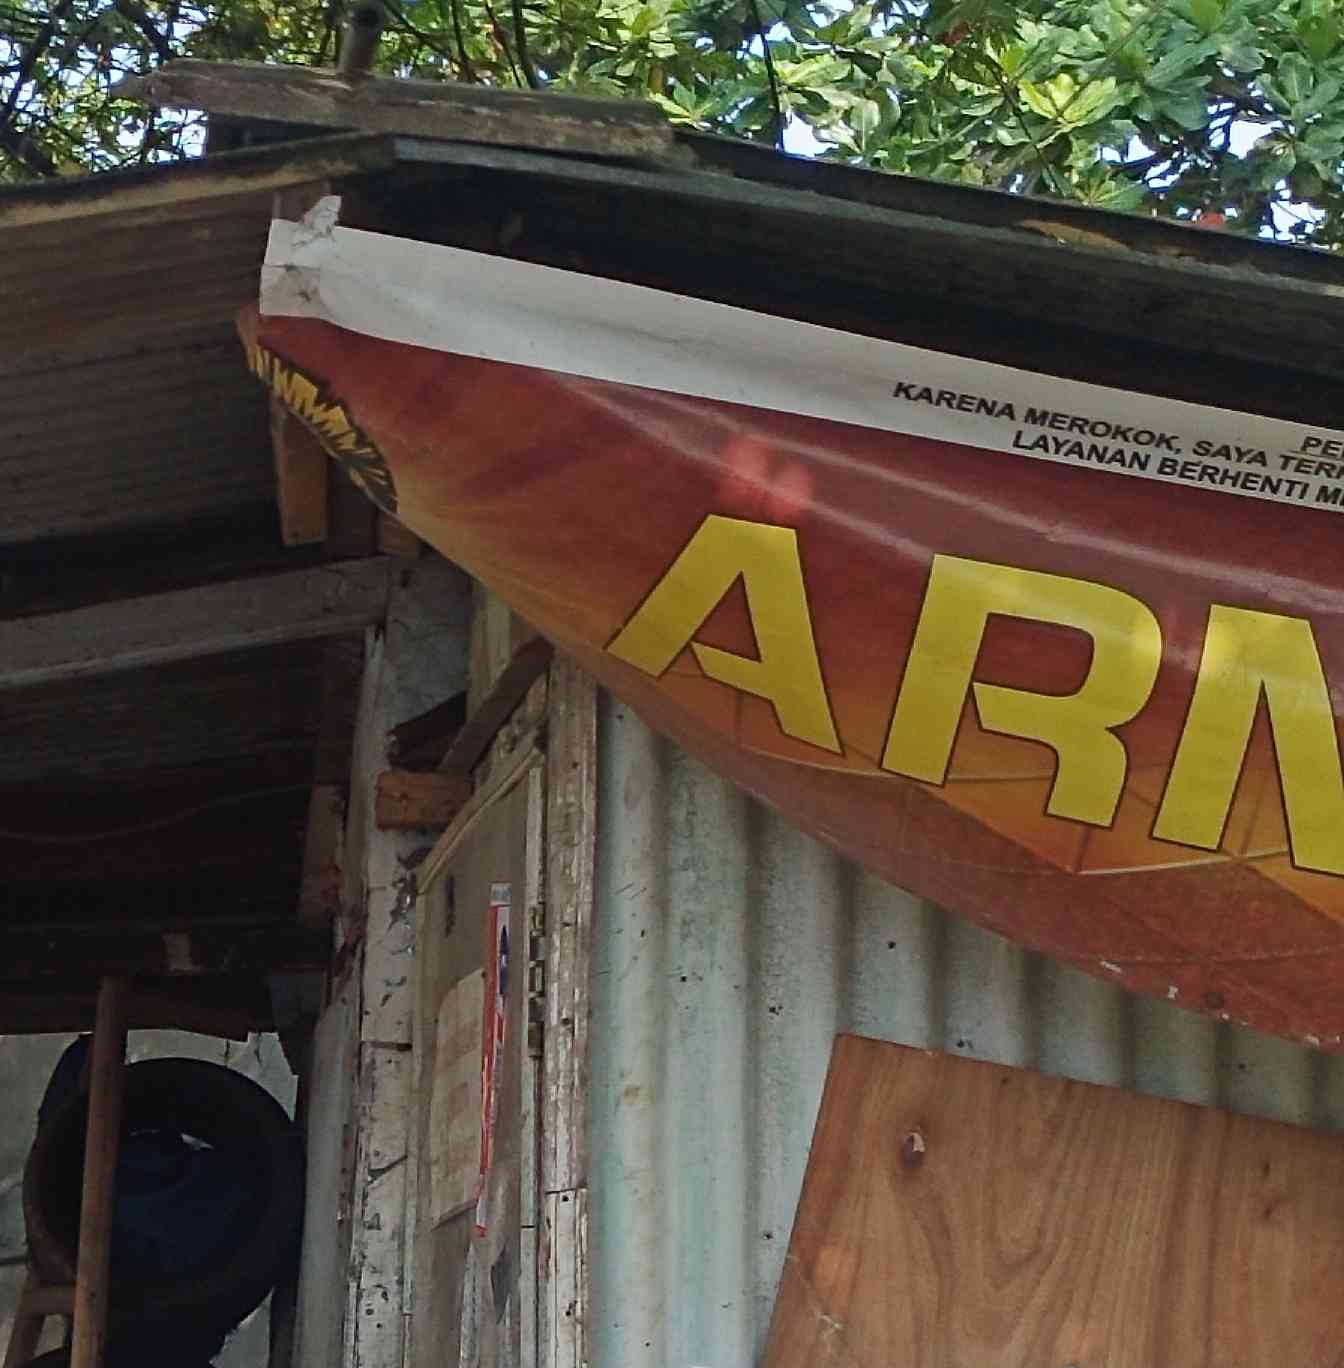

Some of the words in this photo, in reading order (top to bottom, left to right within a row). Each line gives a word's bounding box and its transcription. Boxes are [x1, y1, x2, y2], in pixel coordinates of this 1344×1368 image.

[893, 382, 1016, 421] KARENA
[1024, 407, 1182, 455] MEROKOK,
[1192, 440, 1268, 468] SAYA
[1301, 436, 1344, 459] PE
[1013, 430, 1152, 472] LAYANAN
[1157, 457, 1310, 500] BERHENTI
